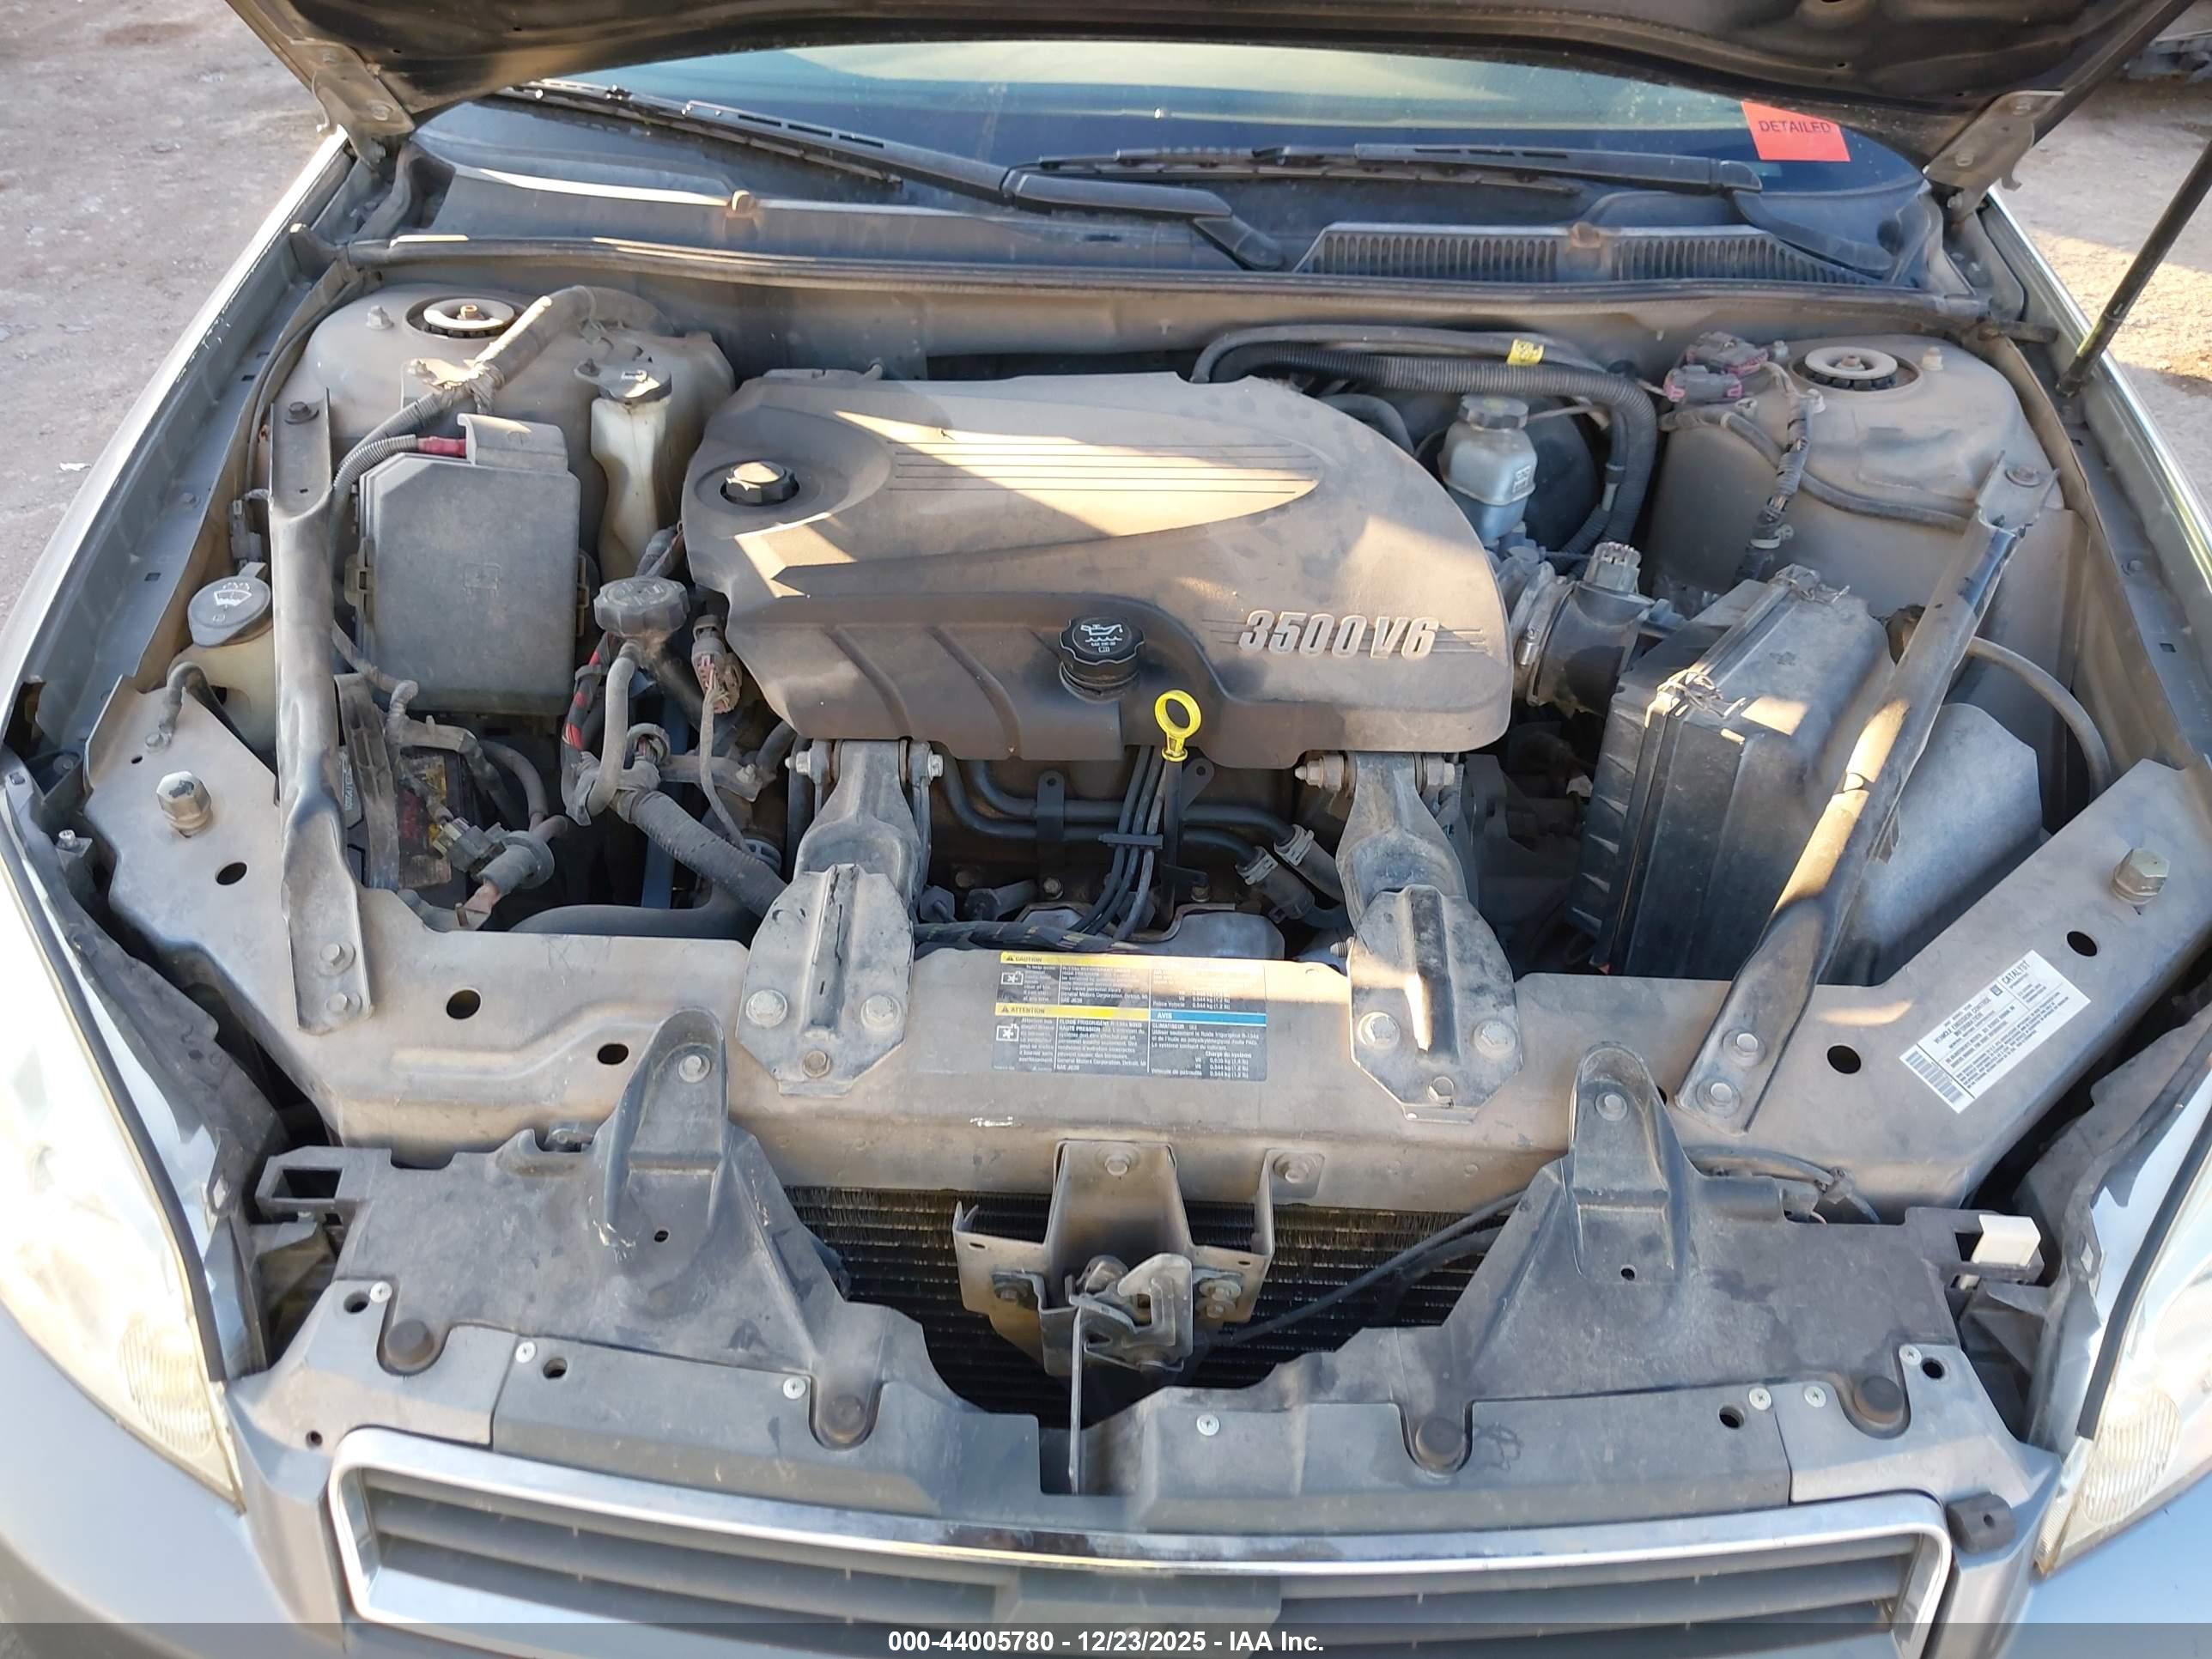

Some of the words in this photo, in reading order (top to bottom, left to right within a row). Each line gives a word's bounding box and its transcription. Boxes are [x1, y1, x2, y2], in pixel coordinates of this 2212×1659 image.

[1759, 119, 1831, 133] DETAILED
[1237, 609, 1370, 658] 3500
[1370, 615, 1440, 660] V6
[2000, 959, 2031, 985] CATALYST
